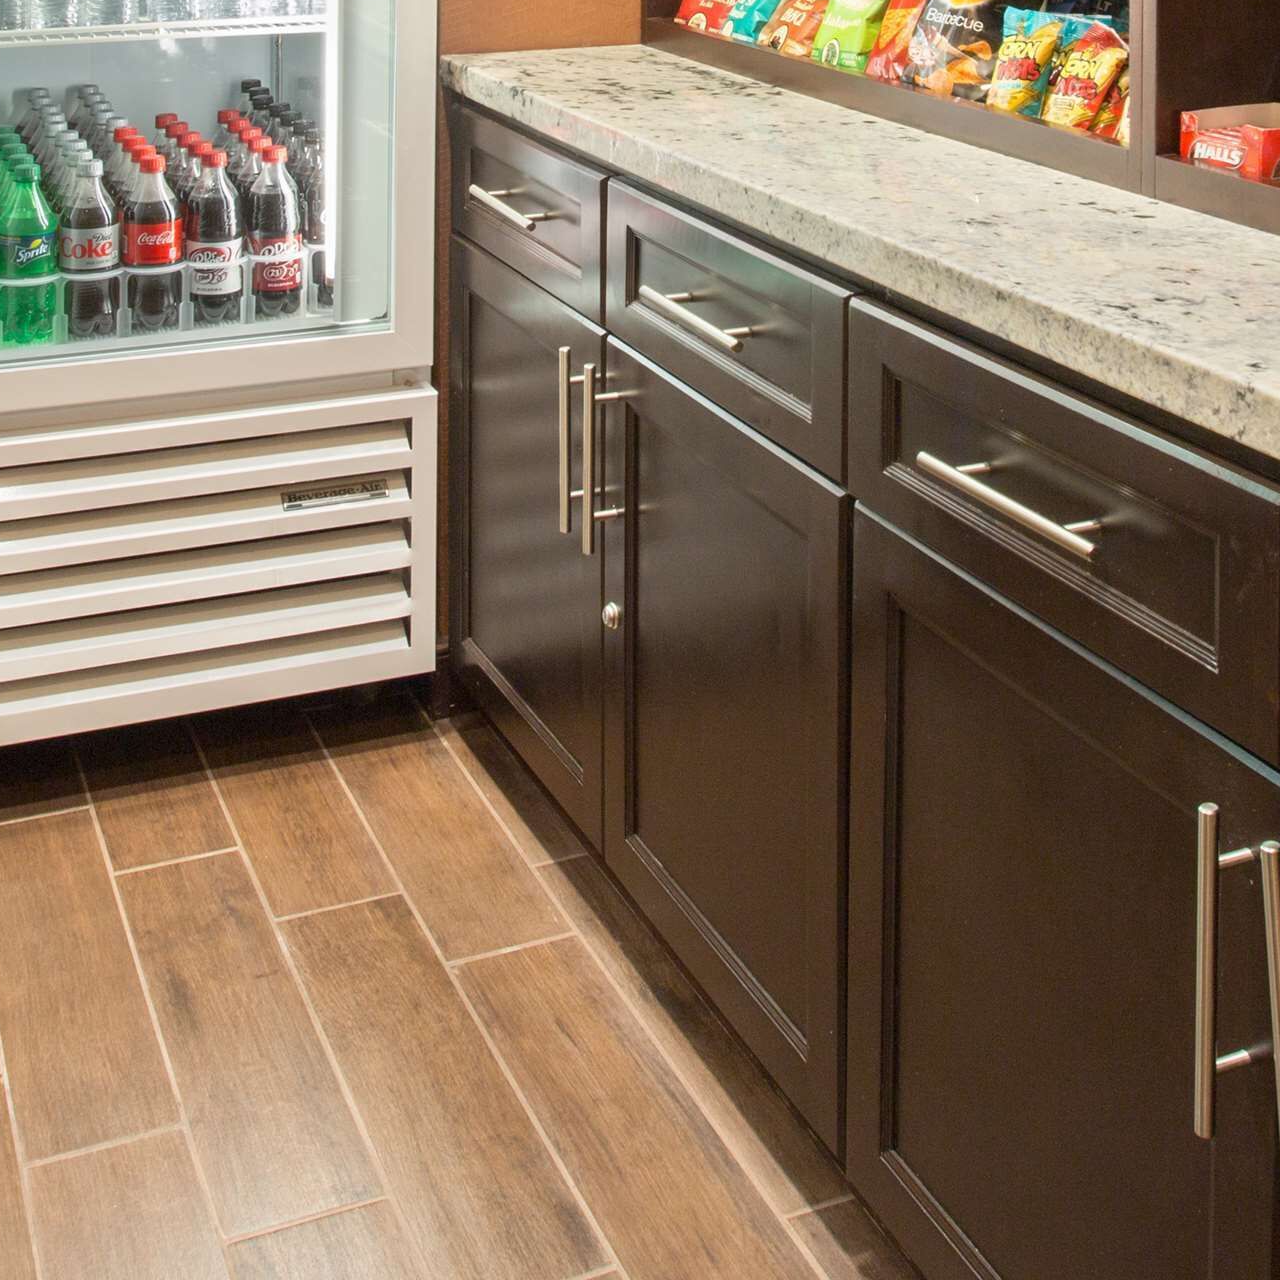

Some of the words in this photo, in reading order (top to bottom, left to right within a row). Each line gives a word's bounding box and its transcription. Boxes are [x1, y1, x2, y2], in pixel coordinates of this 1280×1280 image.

[926, 7, 984, 32] Barbecue
[1193, 141, 1244, 166] HALLS
[16, 243, 49, 264] Sprite
[61, 236, 113, 260] Coke
